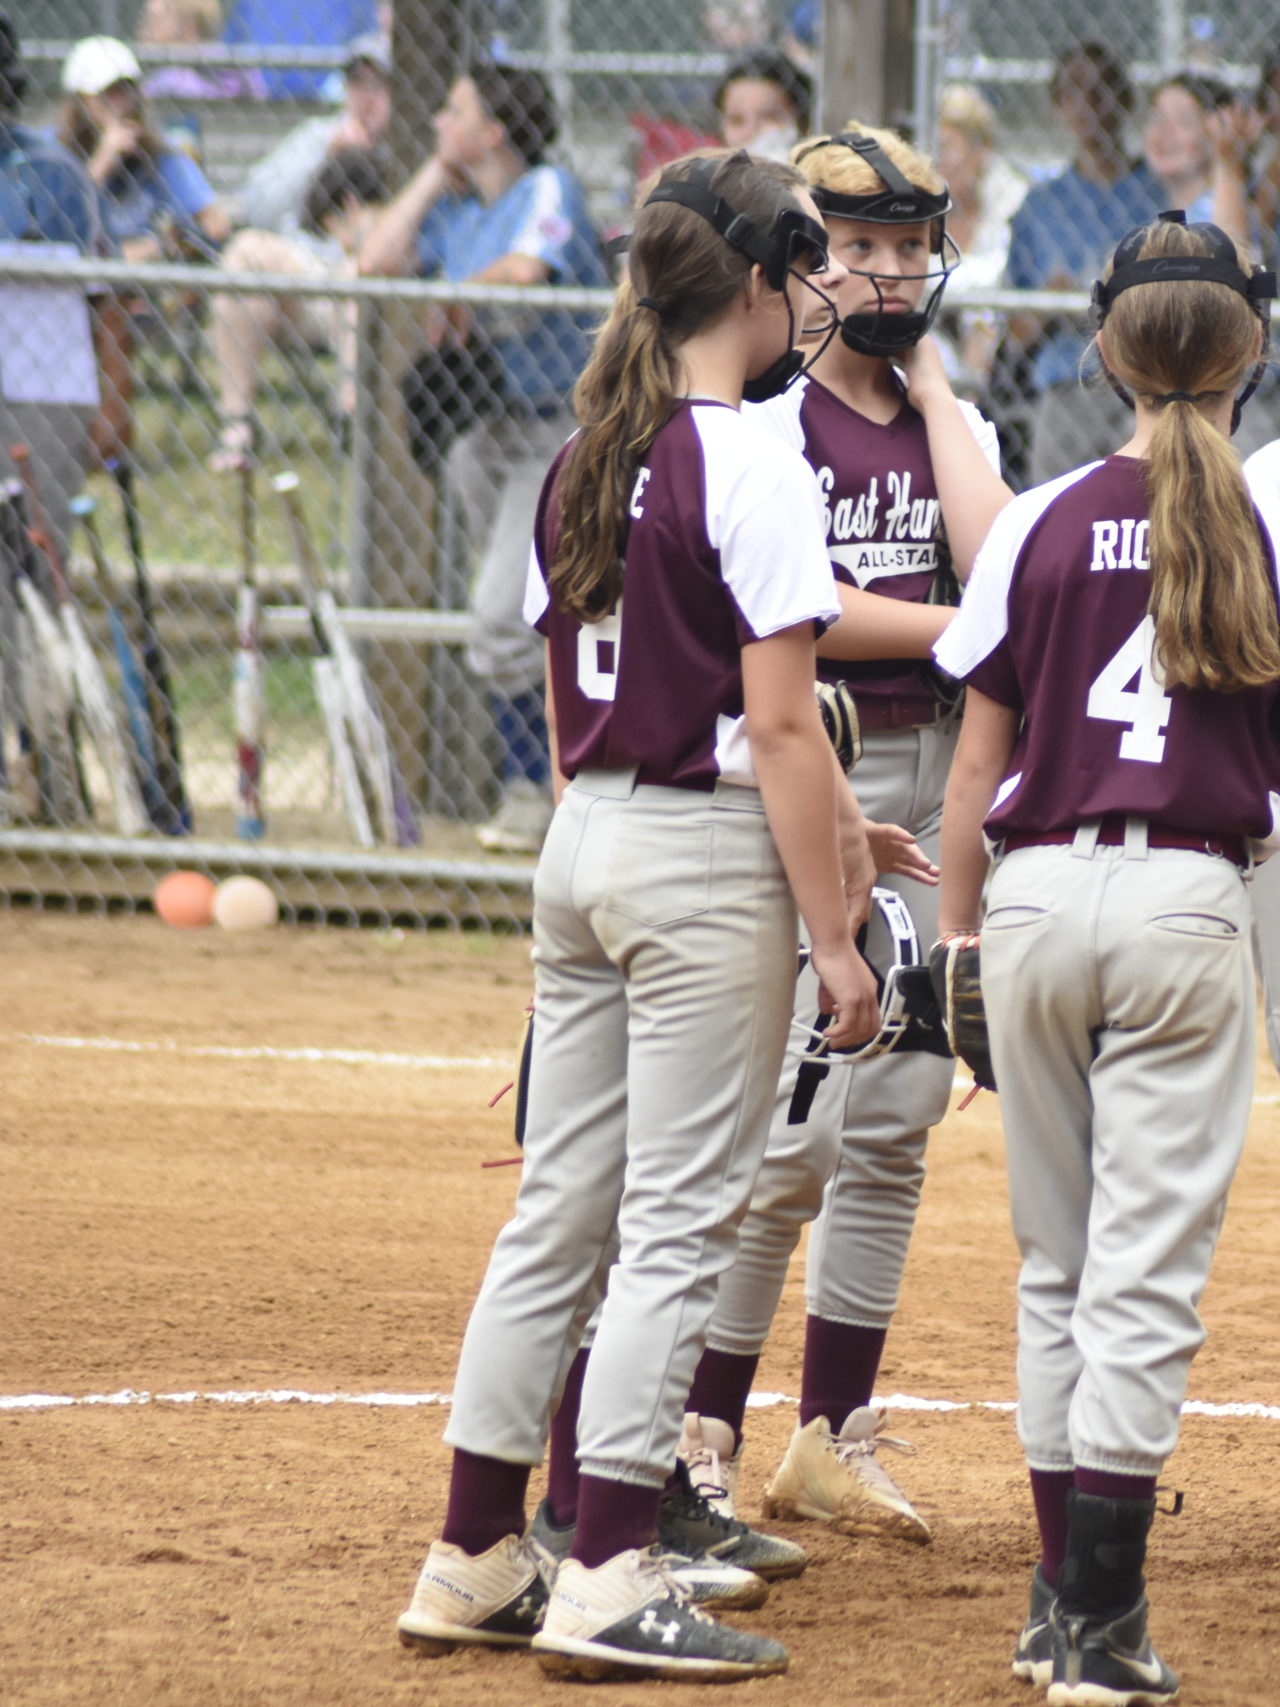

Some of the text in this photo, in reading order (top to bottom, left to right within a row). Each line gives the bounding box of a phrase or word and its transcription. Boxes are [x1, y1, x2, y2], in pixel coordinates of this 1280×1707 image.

[816, 466, 879, 540] East
[857, 549, 938, 569] ALL-STA
[1086, 614, 1172, 763] 4
